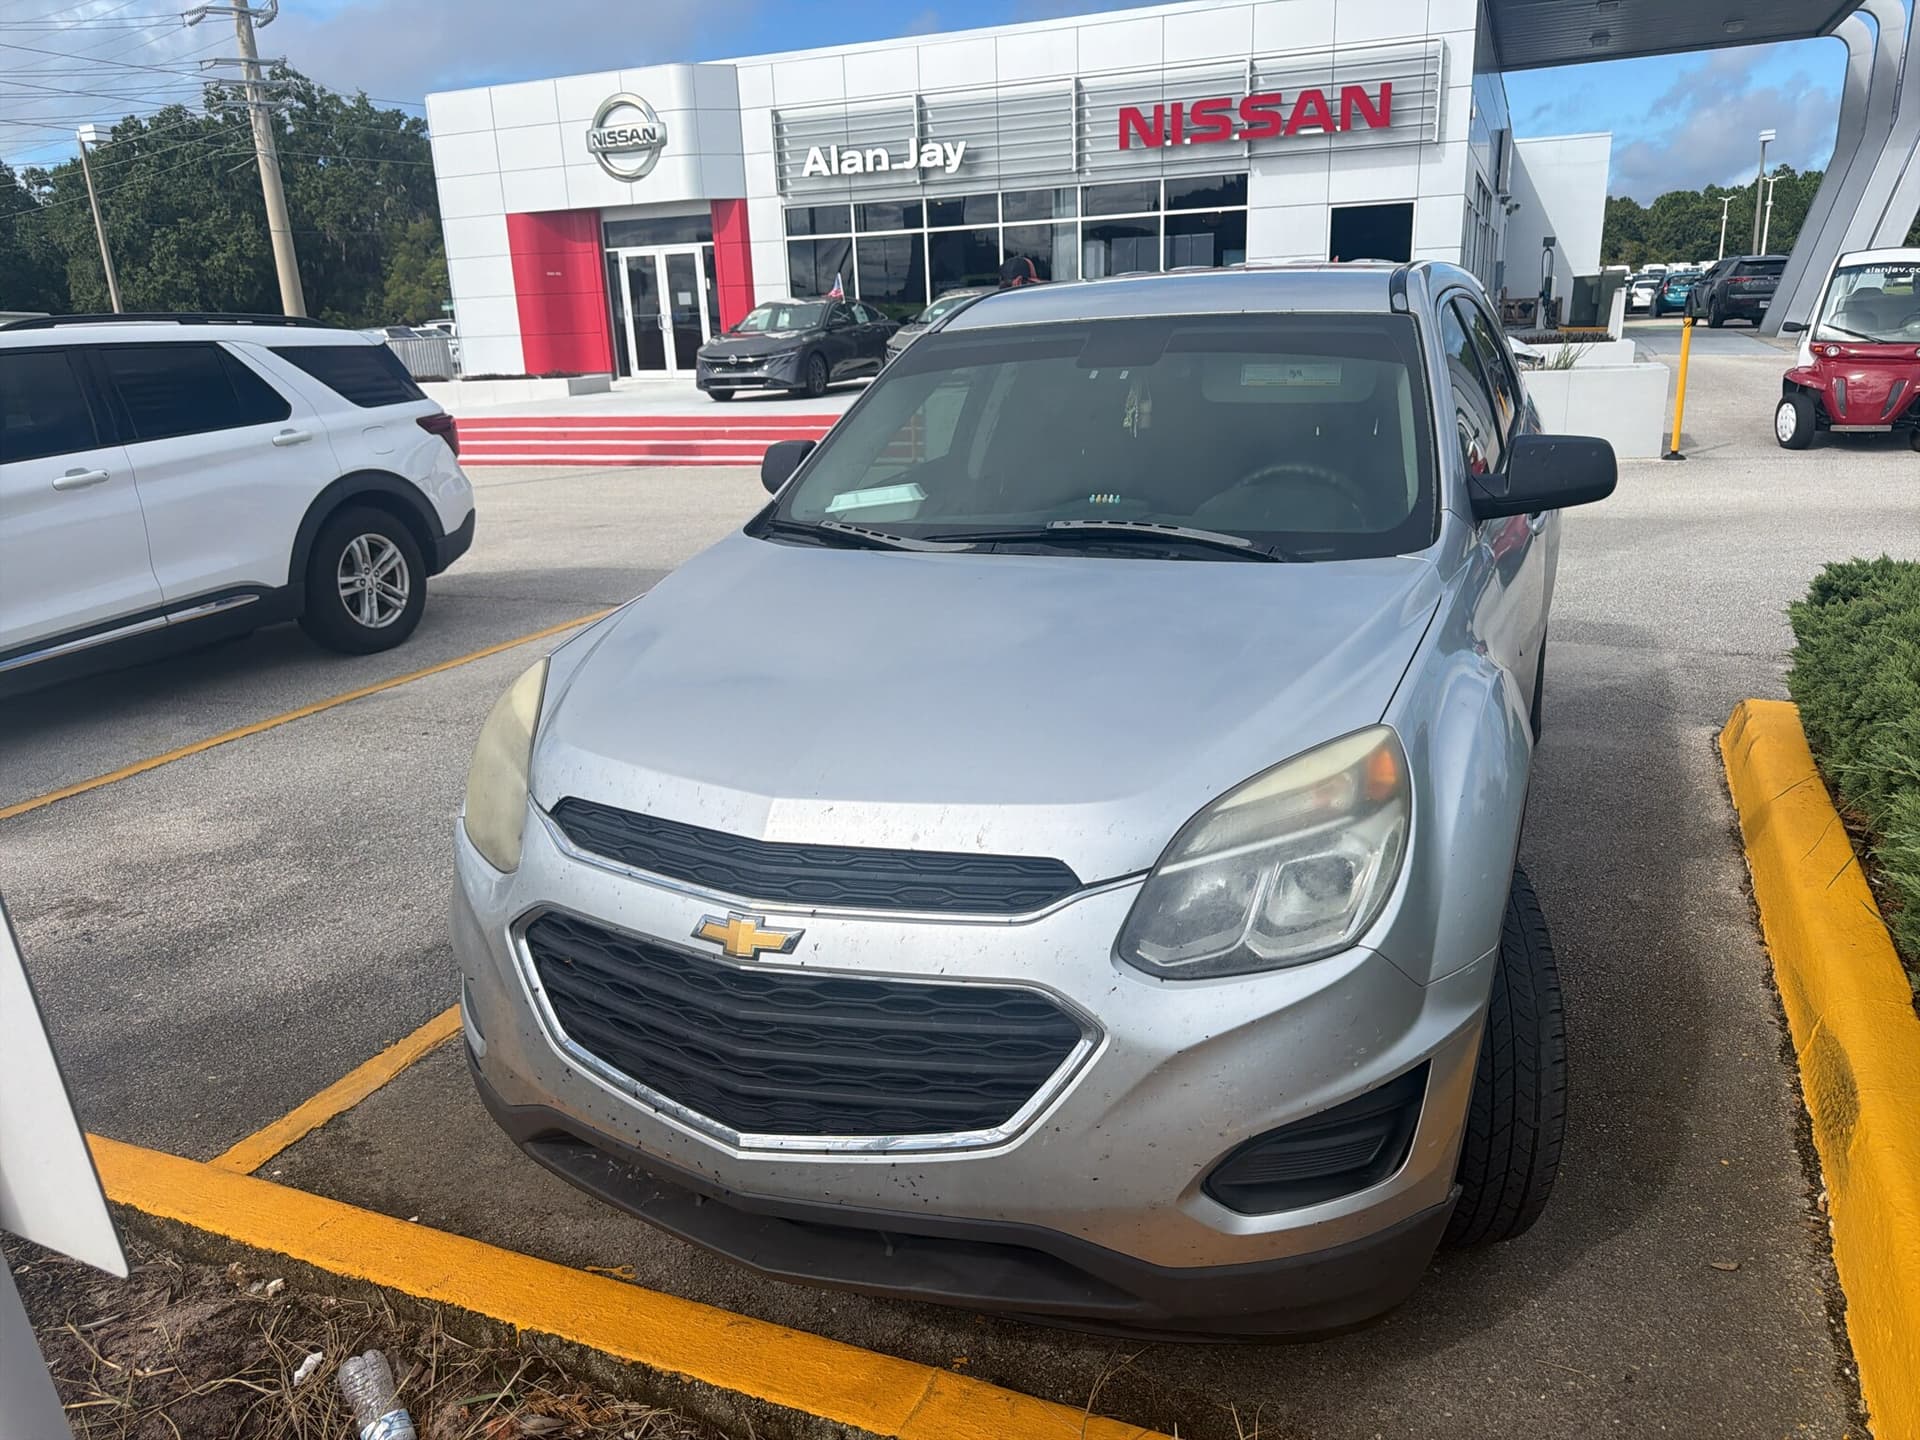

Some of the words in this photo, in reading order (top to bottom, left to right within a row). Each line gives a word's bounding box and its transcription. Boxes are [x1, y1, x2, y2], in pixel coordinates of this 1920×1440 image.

[1118, 82, 1393, 150] NISSAN
[592, 127, 657, 147] NISSAN
[801, 144, 890, 177] Alan
[902, 137, 967, 174] Jay
